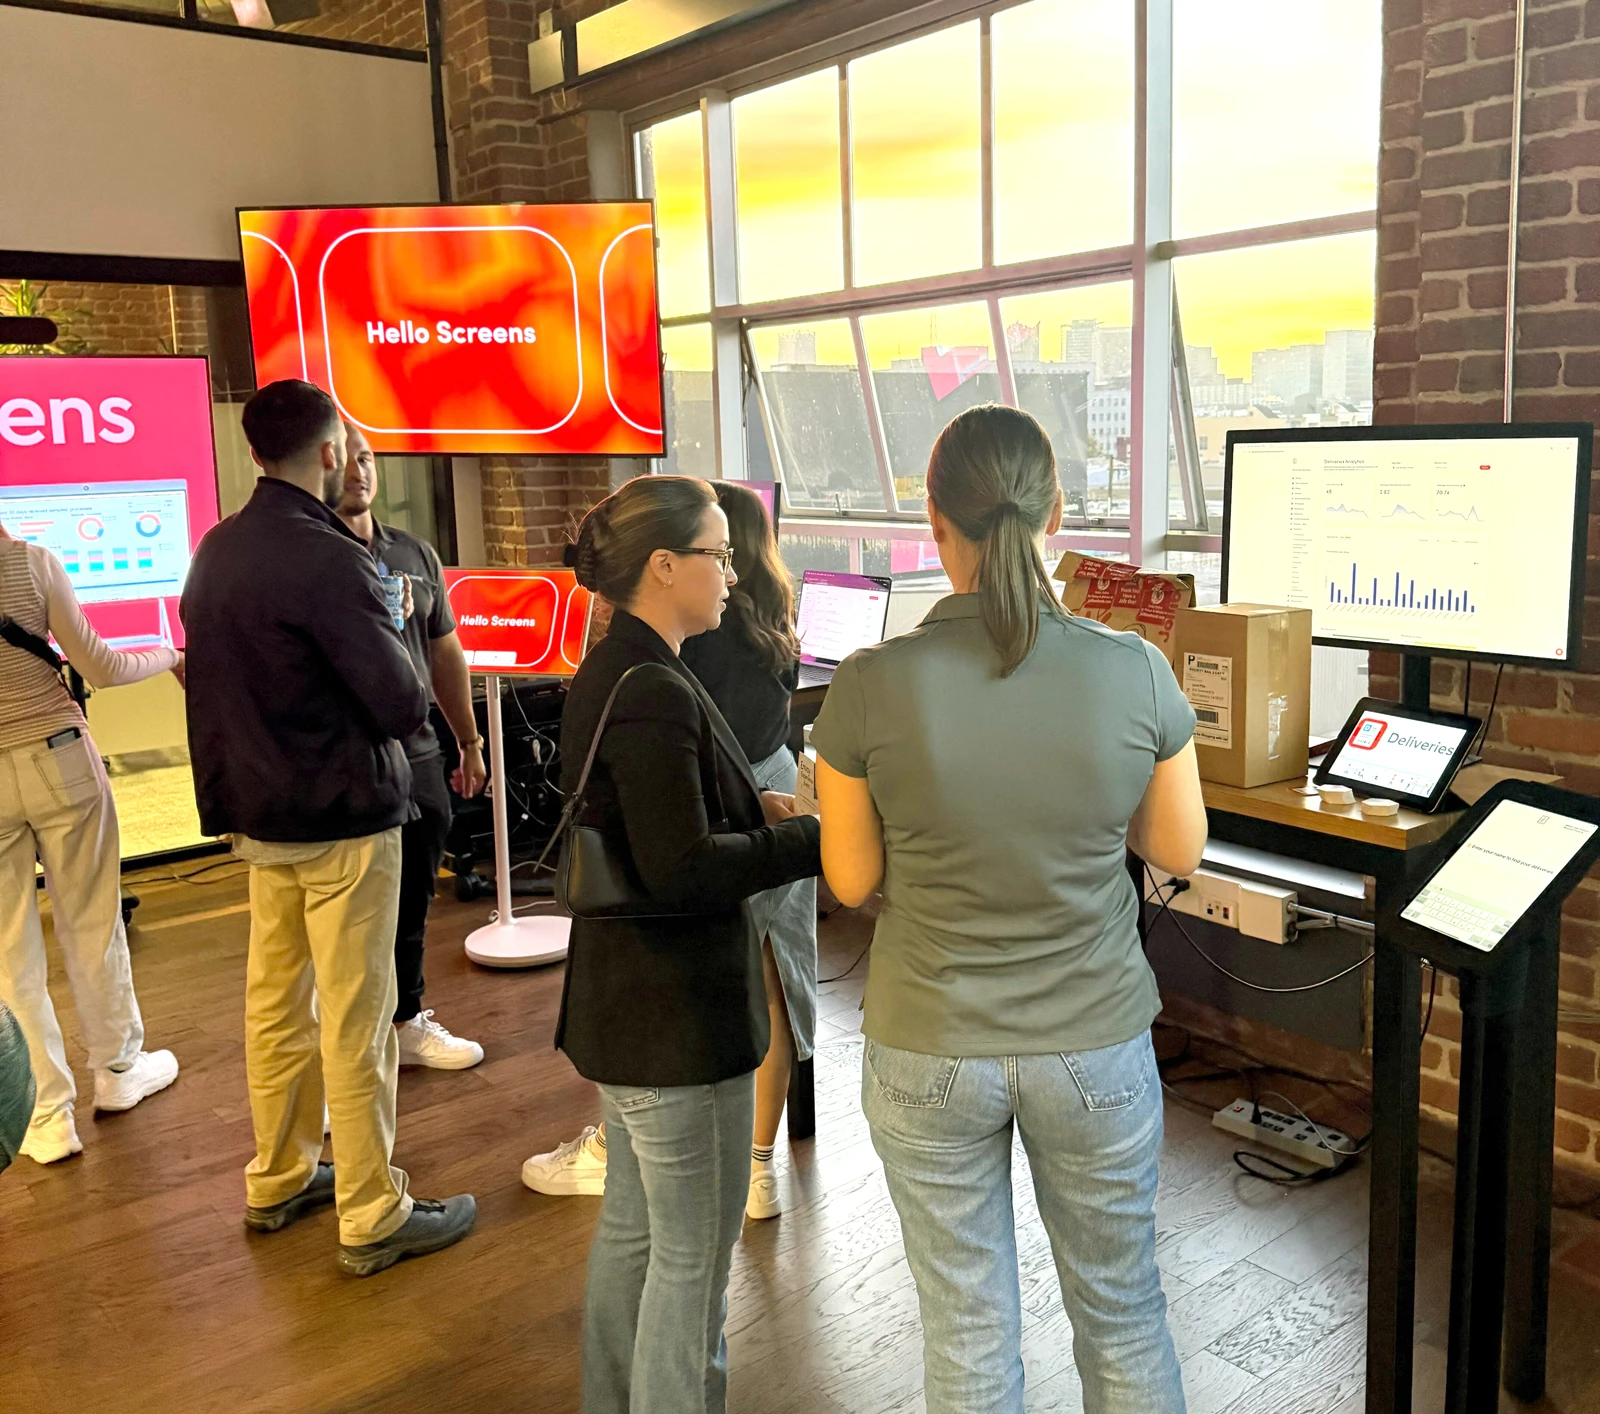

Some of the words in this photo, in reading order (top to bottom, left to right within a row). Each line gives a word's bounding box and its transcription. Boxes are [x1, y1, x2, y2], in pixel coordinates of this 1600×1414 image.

[366, 320, 430, 344] Hello
[436, 320, 537, 344] Screens
[0, 396, 135, 446] ens
[460, 614, 489, 626] Hello
[491, 615, 536, 627] Screens
[1188, 655, 1195, 665] P
[1387, 732, 1455, 756] Deliveries
[1471, 844, 1483, 852] Enter
[1494, 851, 1506, 859] name
